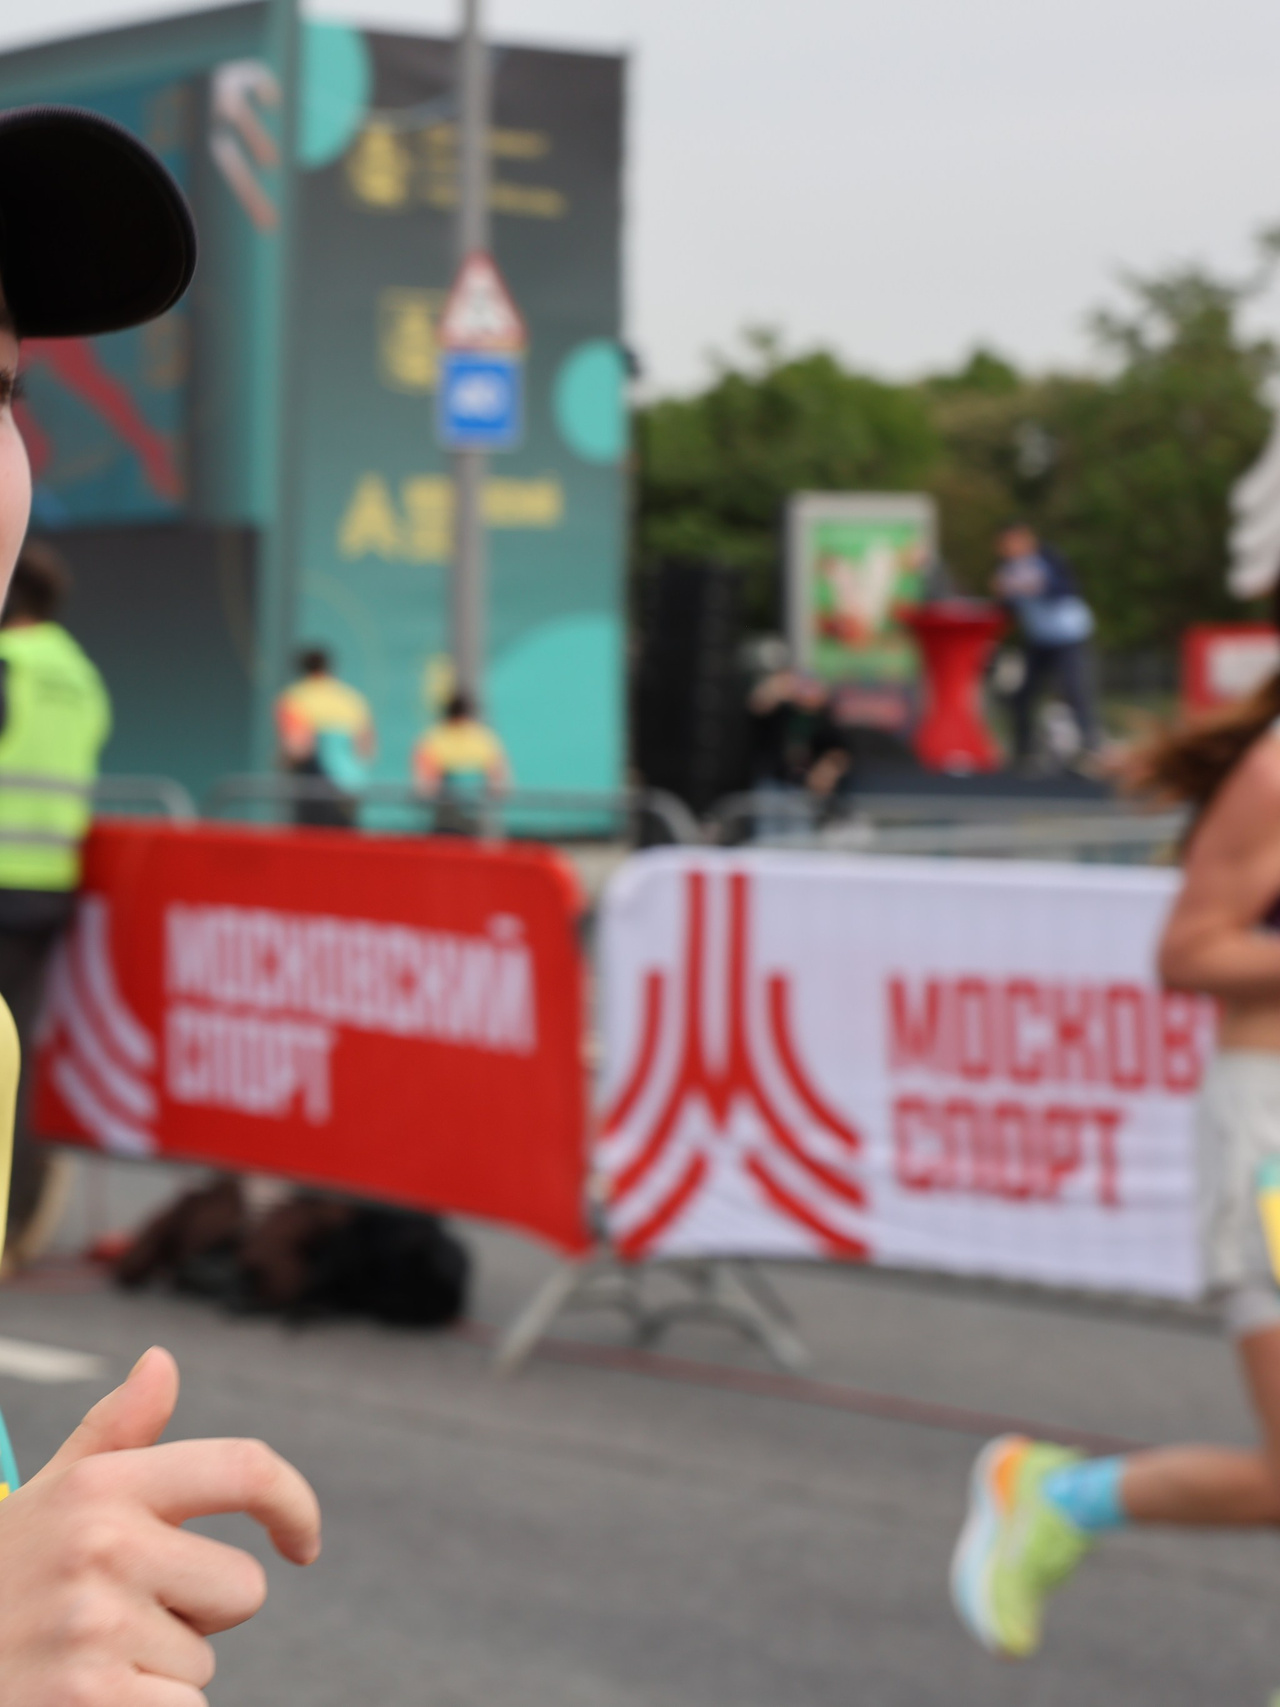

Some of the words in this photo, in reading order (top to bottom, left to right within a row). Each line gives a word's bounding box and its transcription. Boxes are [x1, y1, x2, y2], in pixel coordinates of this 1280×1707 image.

[166, 904, 536, 1057] МОСКОВСКИЙ
[888, 976, 1224, 1096] МОСКОВ
[167, 1006, 336, 1124] СПОРТ
[893, 1096, 1124, 1212] СПОРТ
